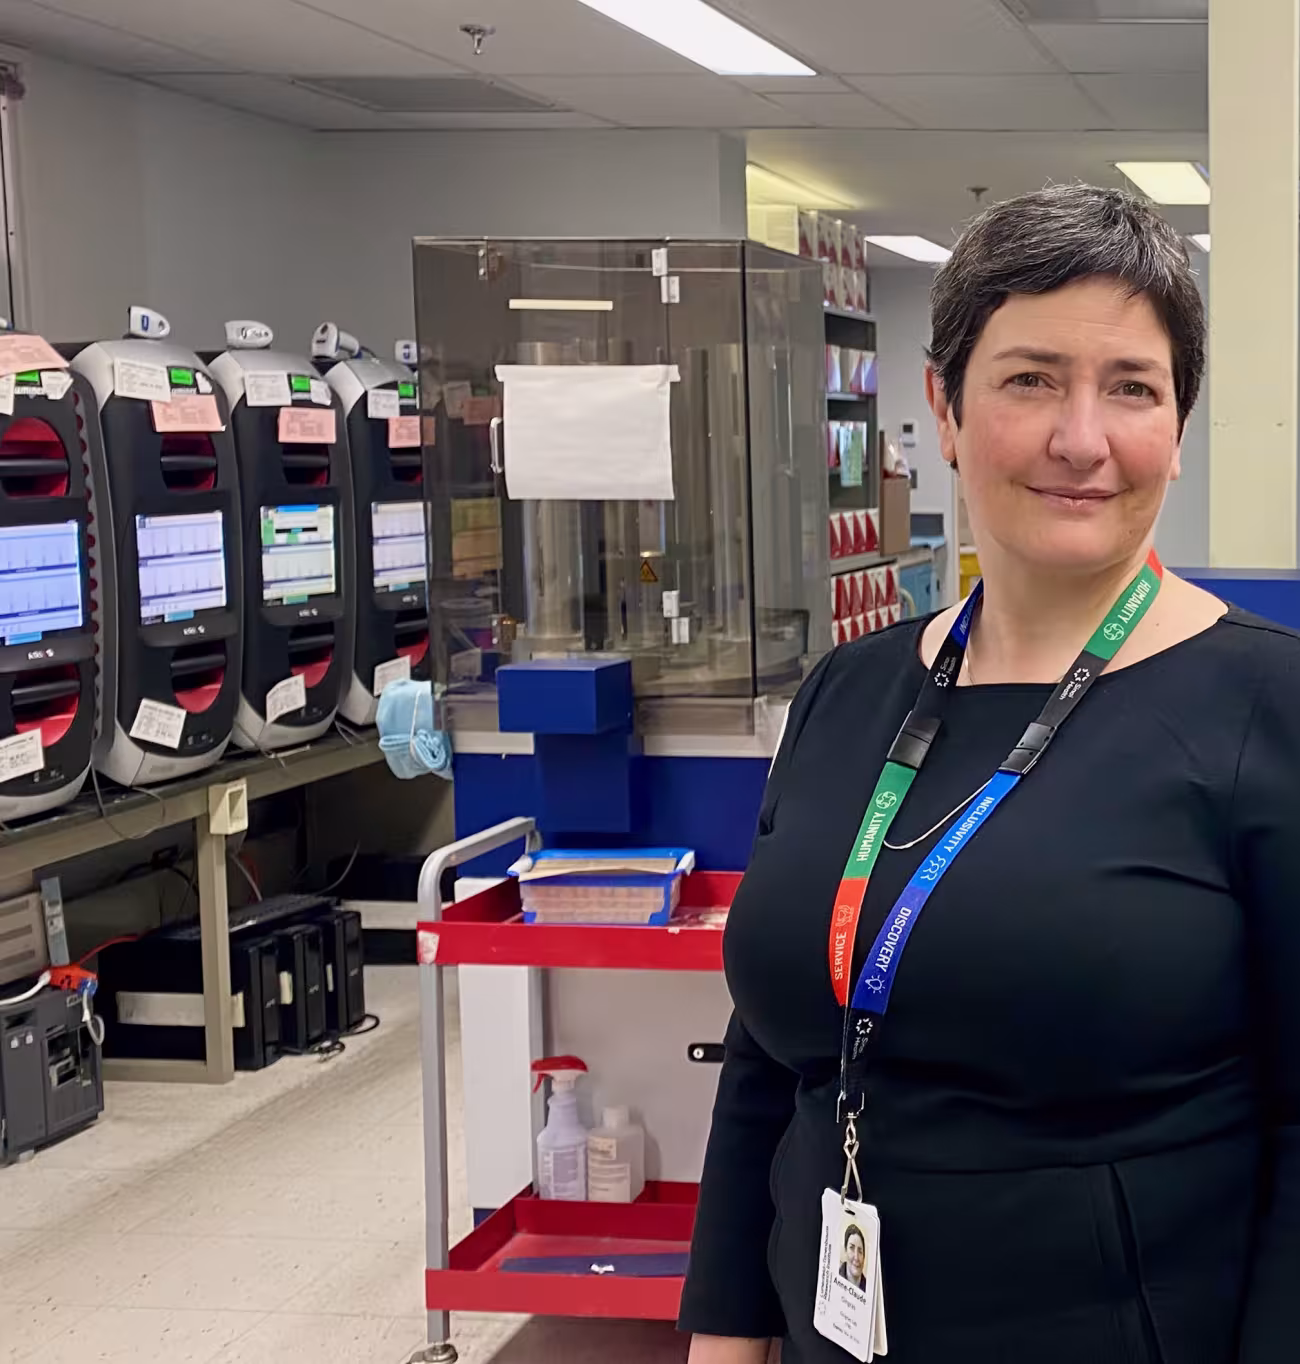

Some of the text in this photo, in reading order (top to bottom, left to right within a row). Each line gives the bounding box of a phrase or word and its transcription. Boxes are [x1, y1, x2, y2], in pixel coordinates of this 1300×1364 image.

[1117, 579, 1152, 624] HUMANITY
[1059, 680, 1075, 701] Health
[1068, 683, 1082, 699] Sinai
[856, 811, 886, 862] HUMANITY
[943, 796, 995, 853] INCLUSIVITY
[834, 931, 847, 981] SERVICE
[875, 906, 912, 973] DISCOVERY
